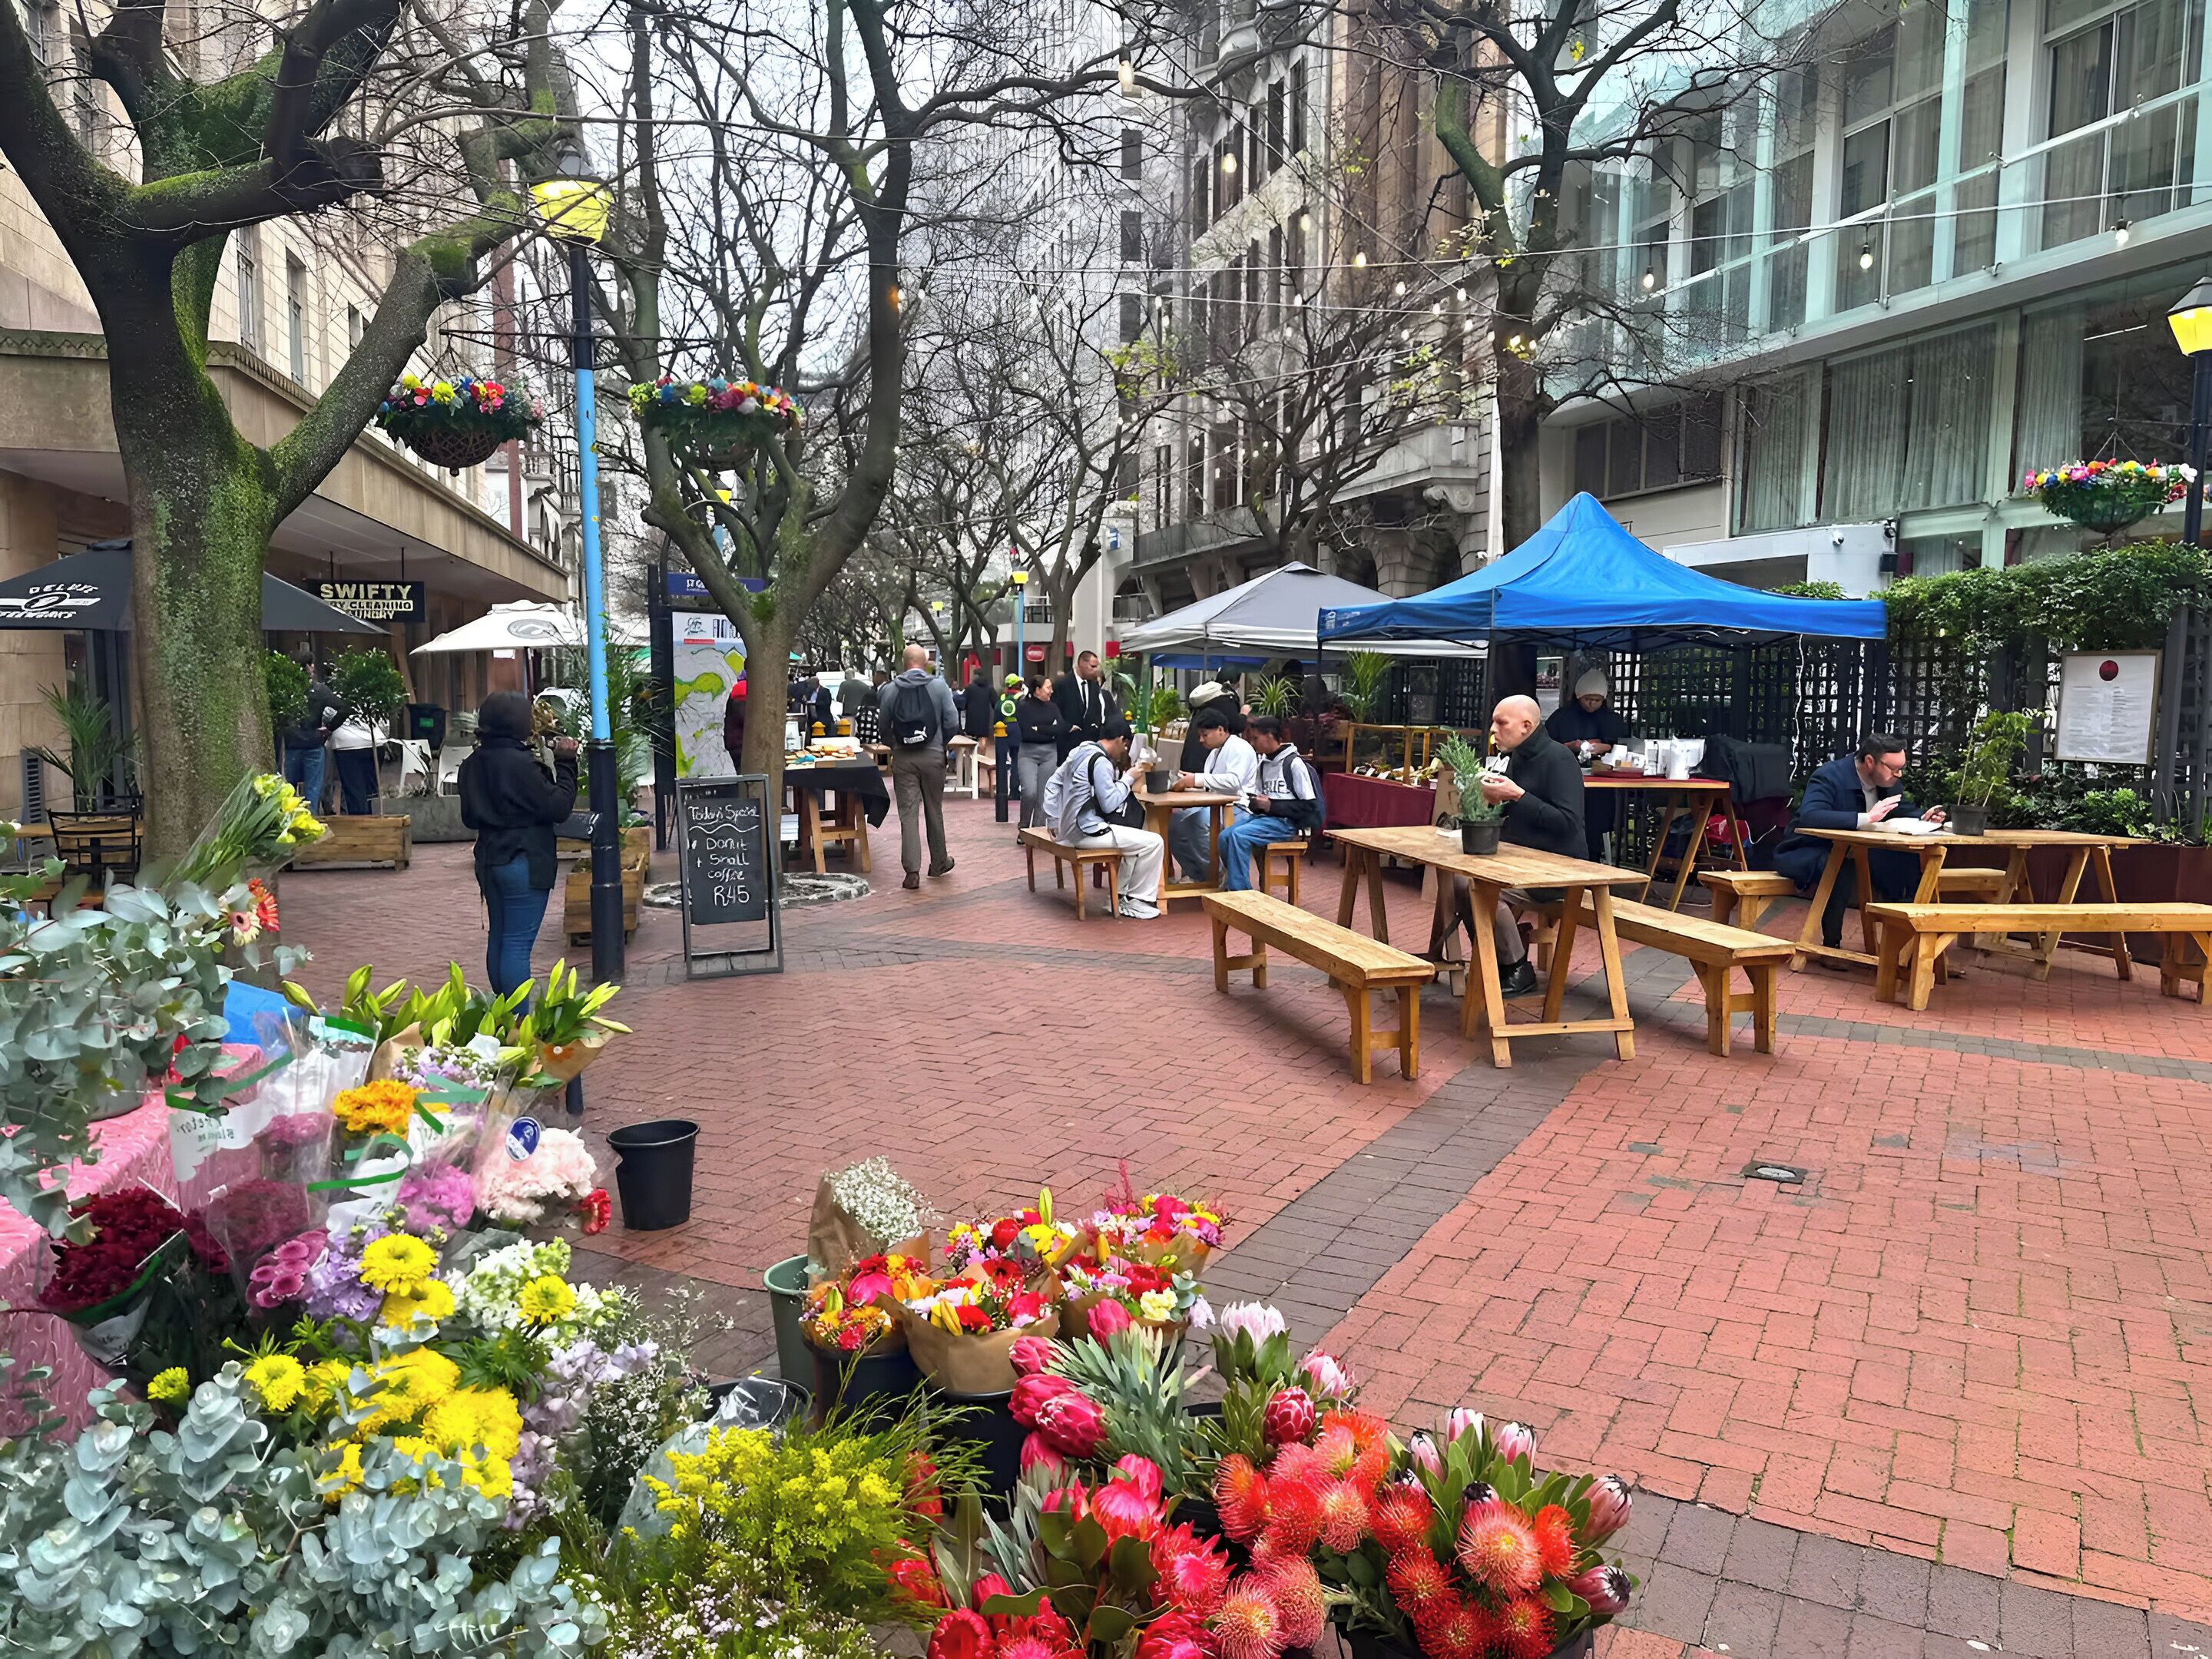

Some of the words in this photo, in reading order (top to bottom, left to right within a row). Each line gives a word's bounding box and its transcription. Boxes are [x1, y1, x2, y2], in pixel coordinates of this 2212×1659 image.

[320, 583, 411, 600] SWIFTY
[349, 601, 412, 610] CLEANING
[714, 885, 750, 906] R45
